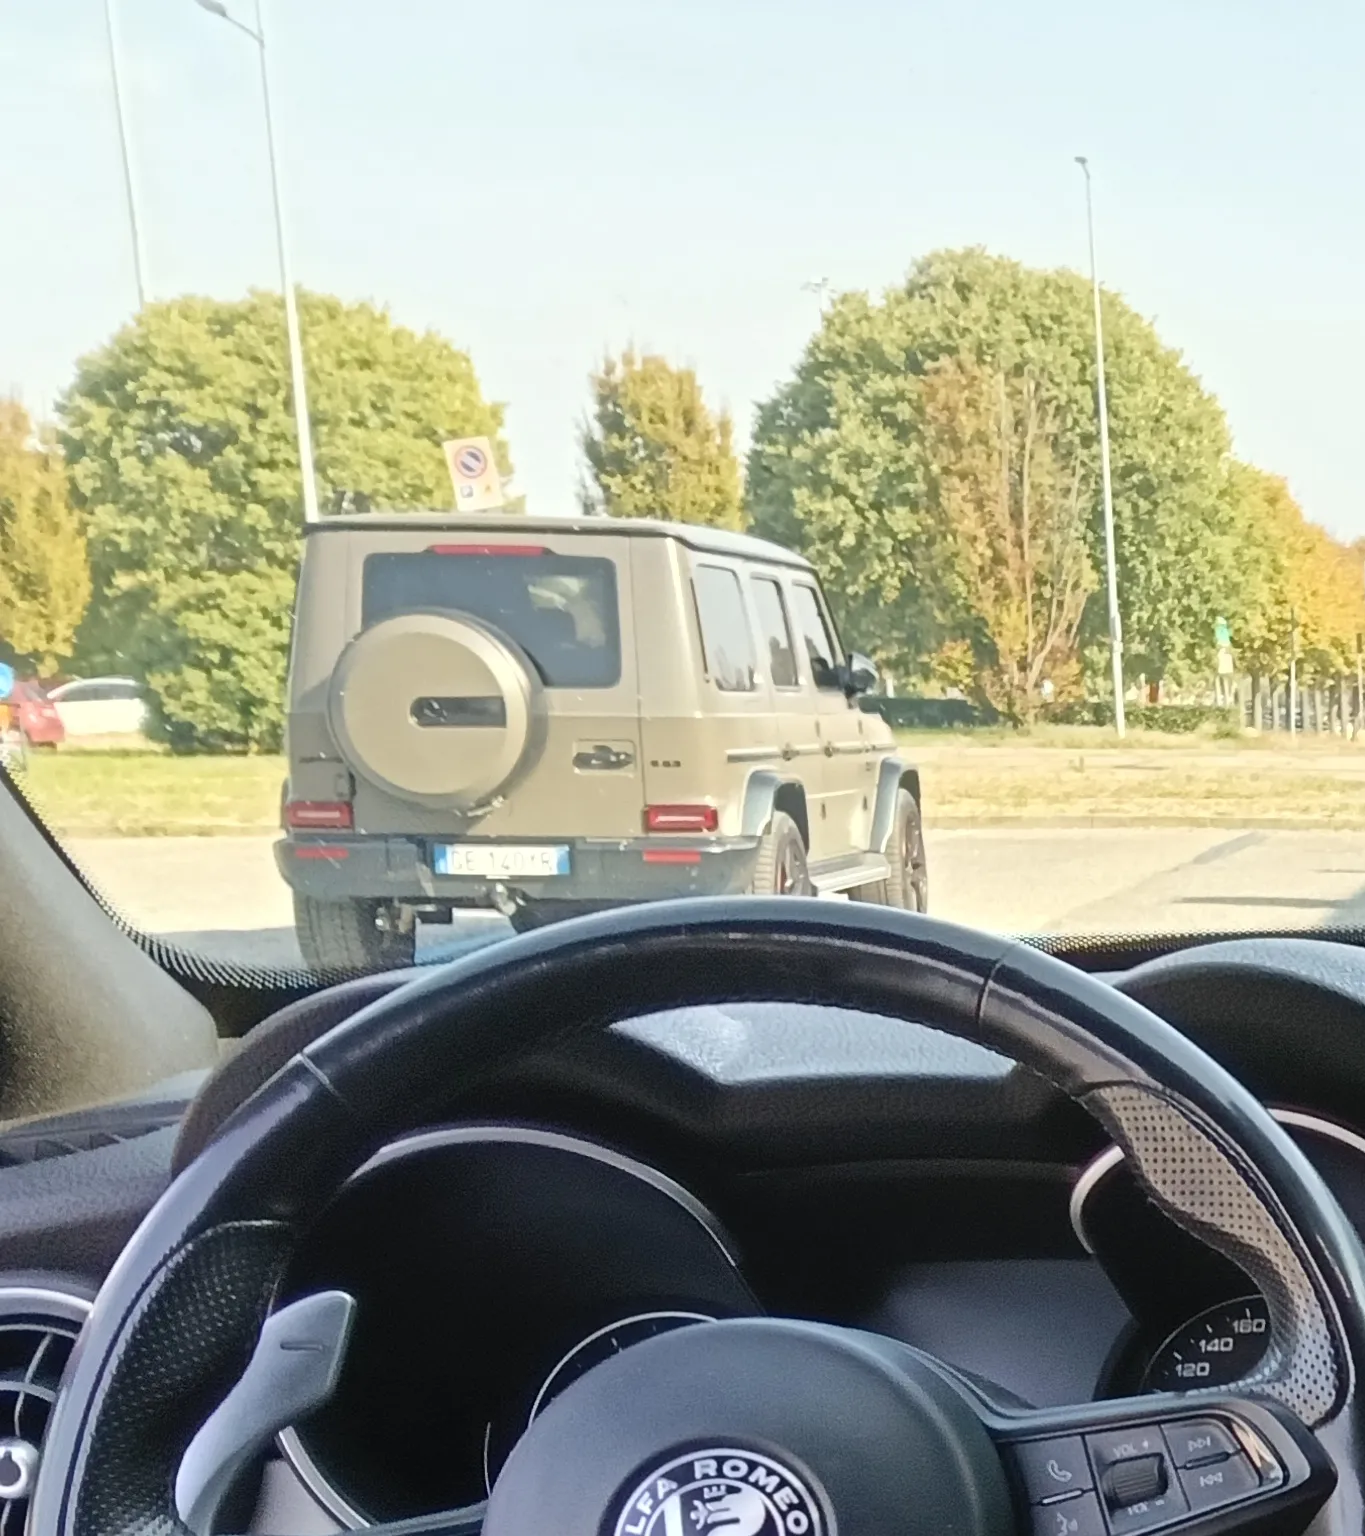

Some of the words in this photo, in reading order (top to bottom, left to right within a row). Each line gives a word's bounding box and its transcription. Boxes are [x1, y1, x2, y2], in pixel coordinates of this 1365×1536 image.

[1231, 1318, 1267, 1333] 160
[1199, 1337, 1234, 1353] 140
[1175, 1362, 1210, 1378] 120
[694, 1458, 810, 1536] ROMEO
